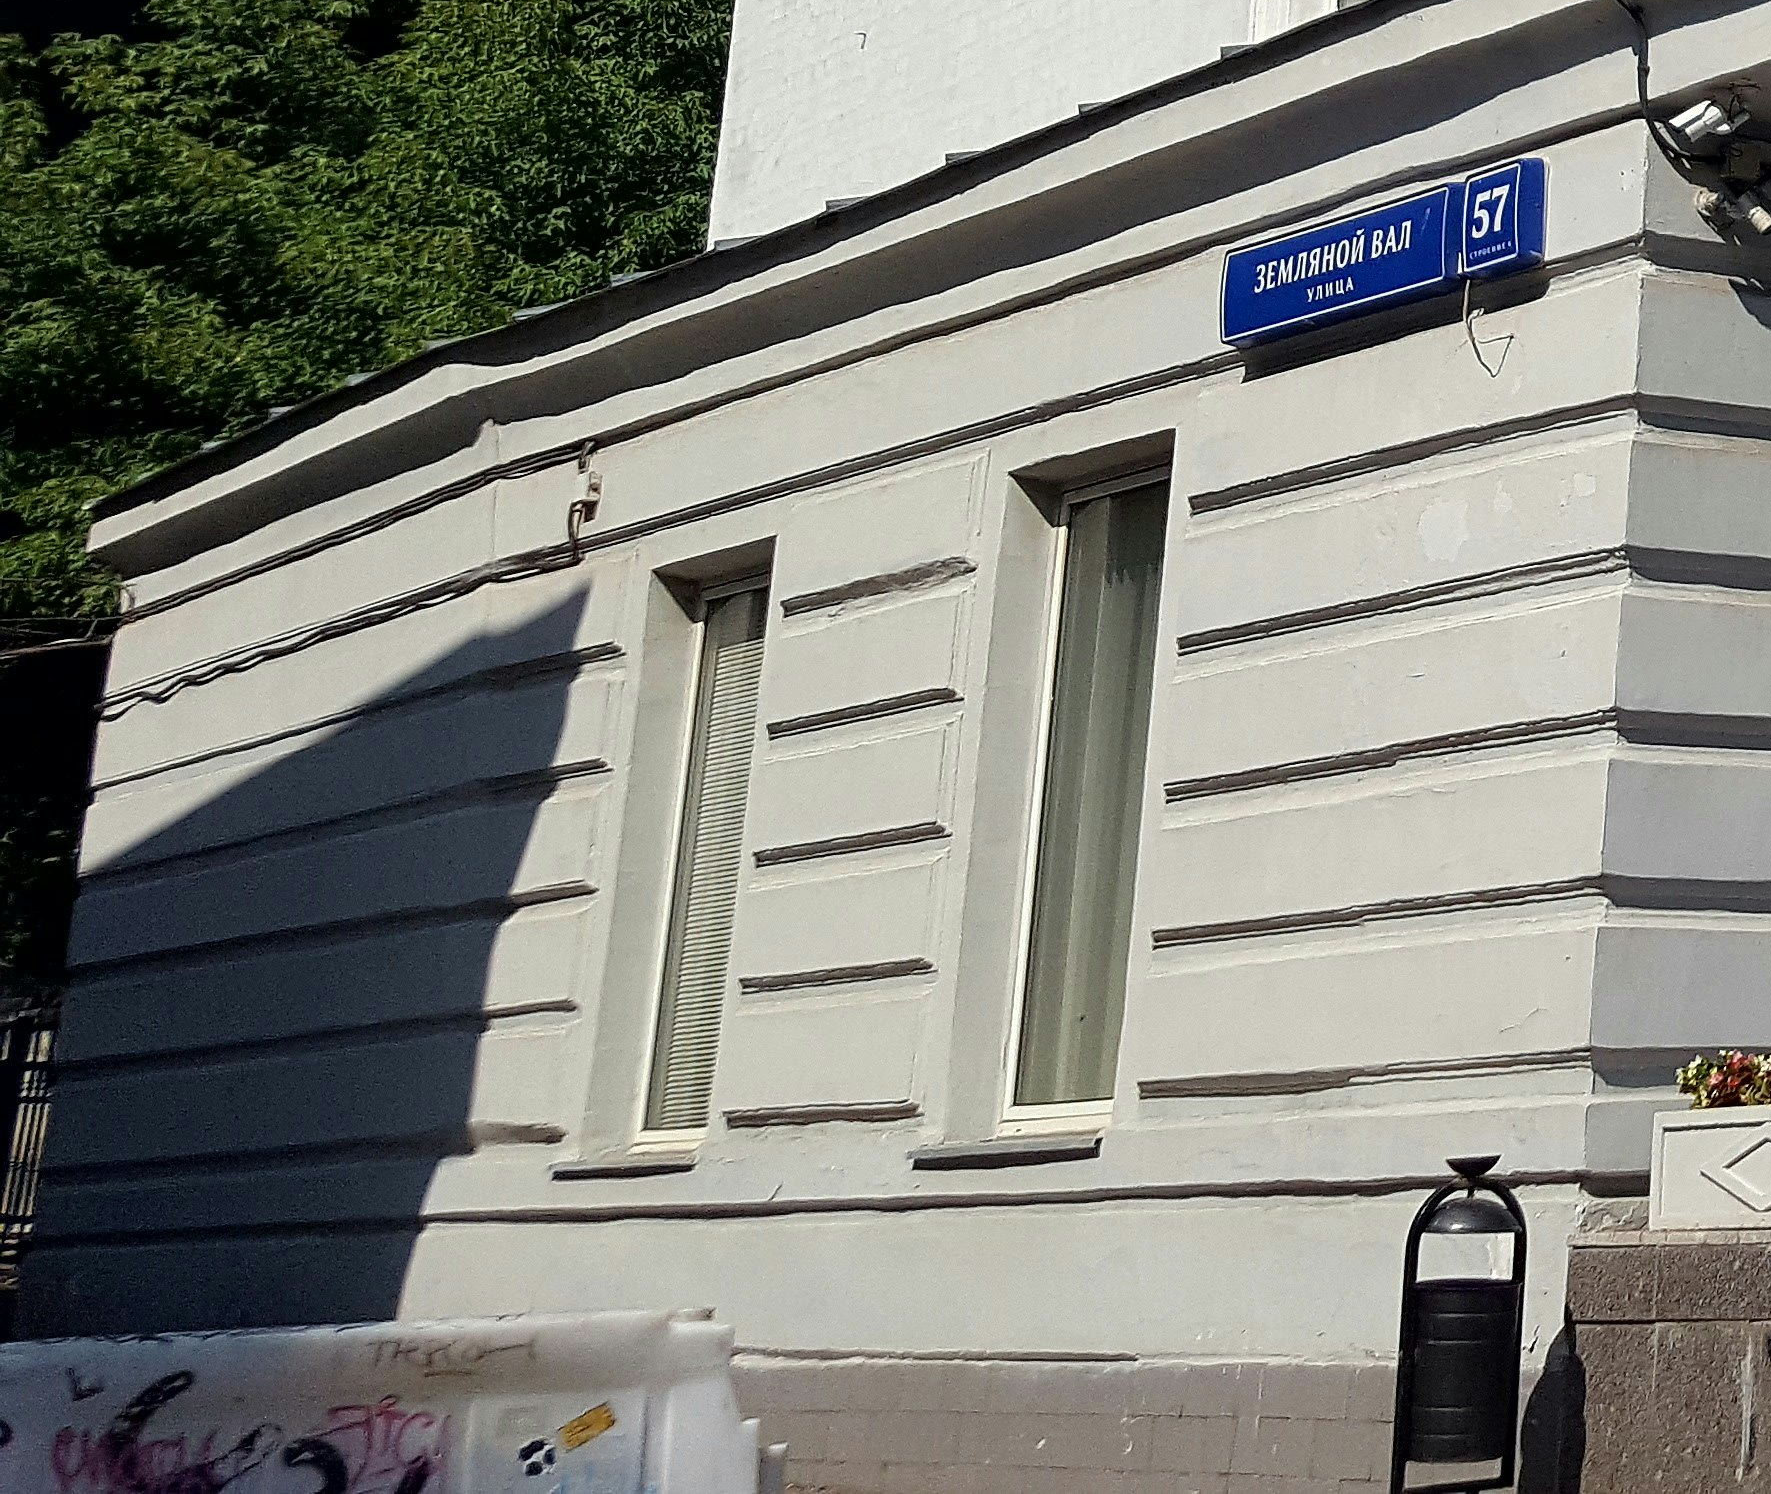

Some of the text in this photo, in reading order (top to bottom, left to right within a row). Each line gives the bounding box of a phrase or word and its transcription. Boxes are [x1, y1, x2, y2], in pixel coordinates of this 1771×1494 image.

[1472, 184, 1510, 238] 57
[1254, 220, 1412, 294] ЗЕМЛЯНОЙ ВАЛ
[1306, 276, 1354, 305] УЛИЦА
